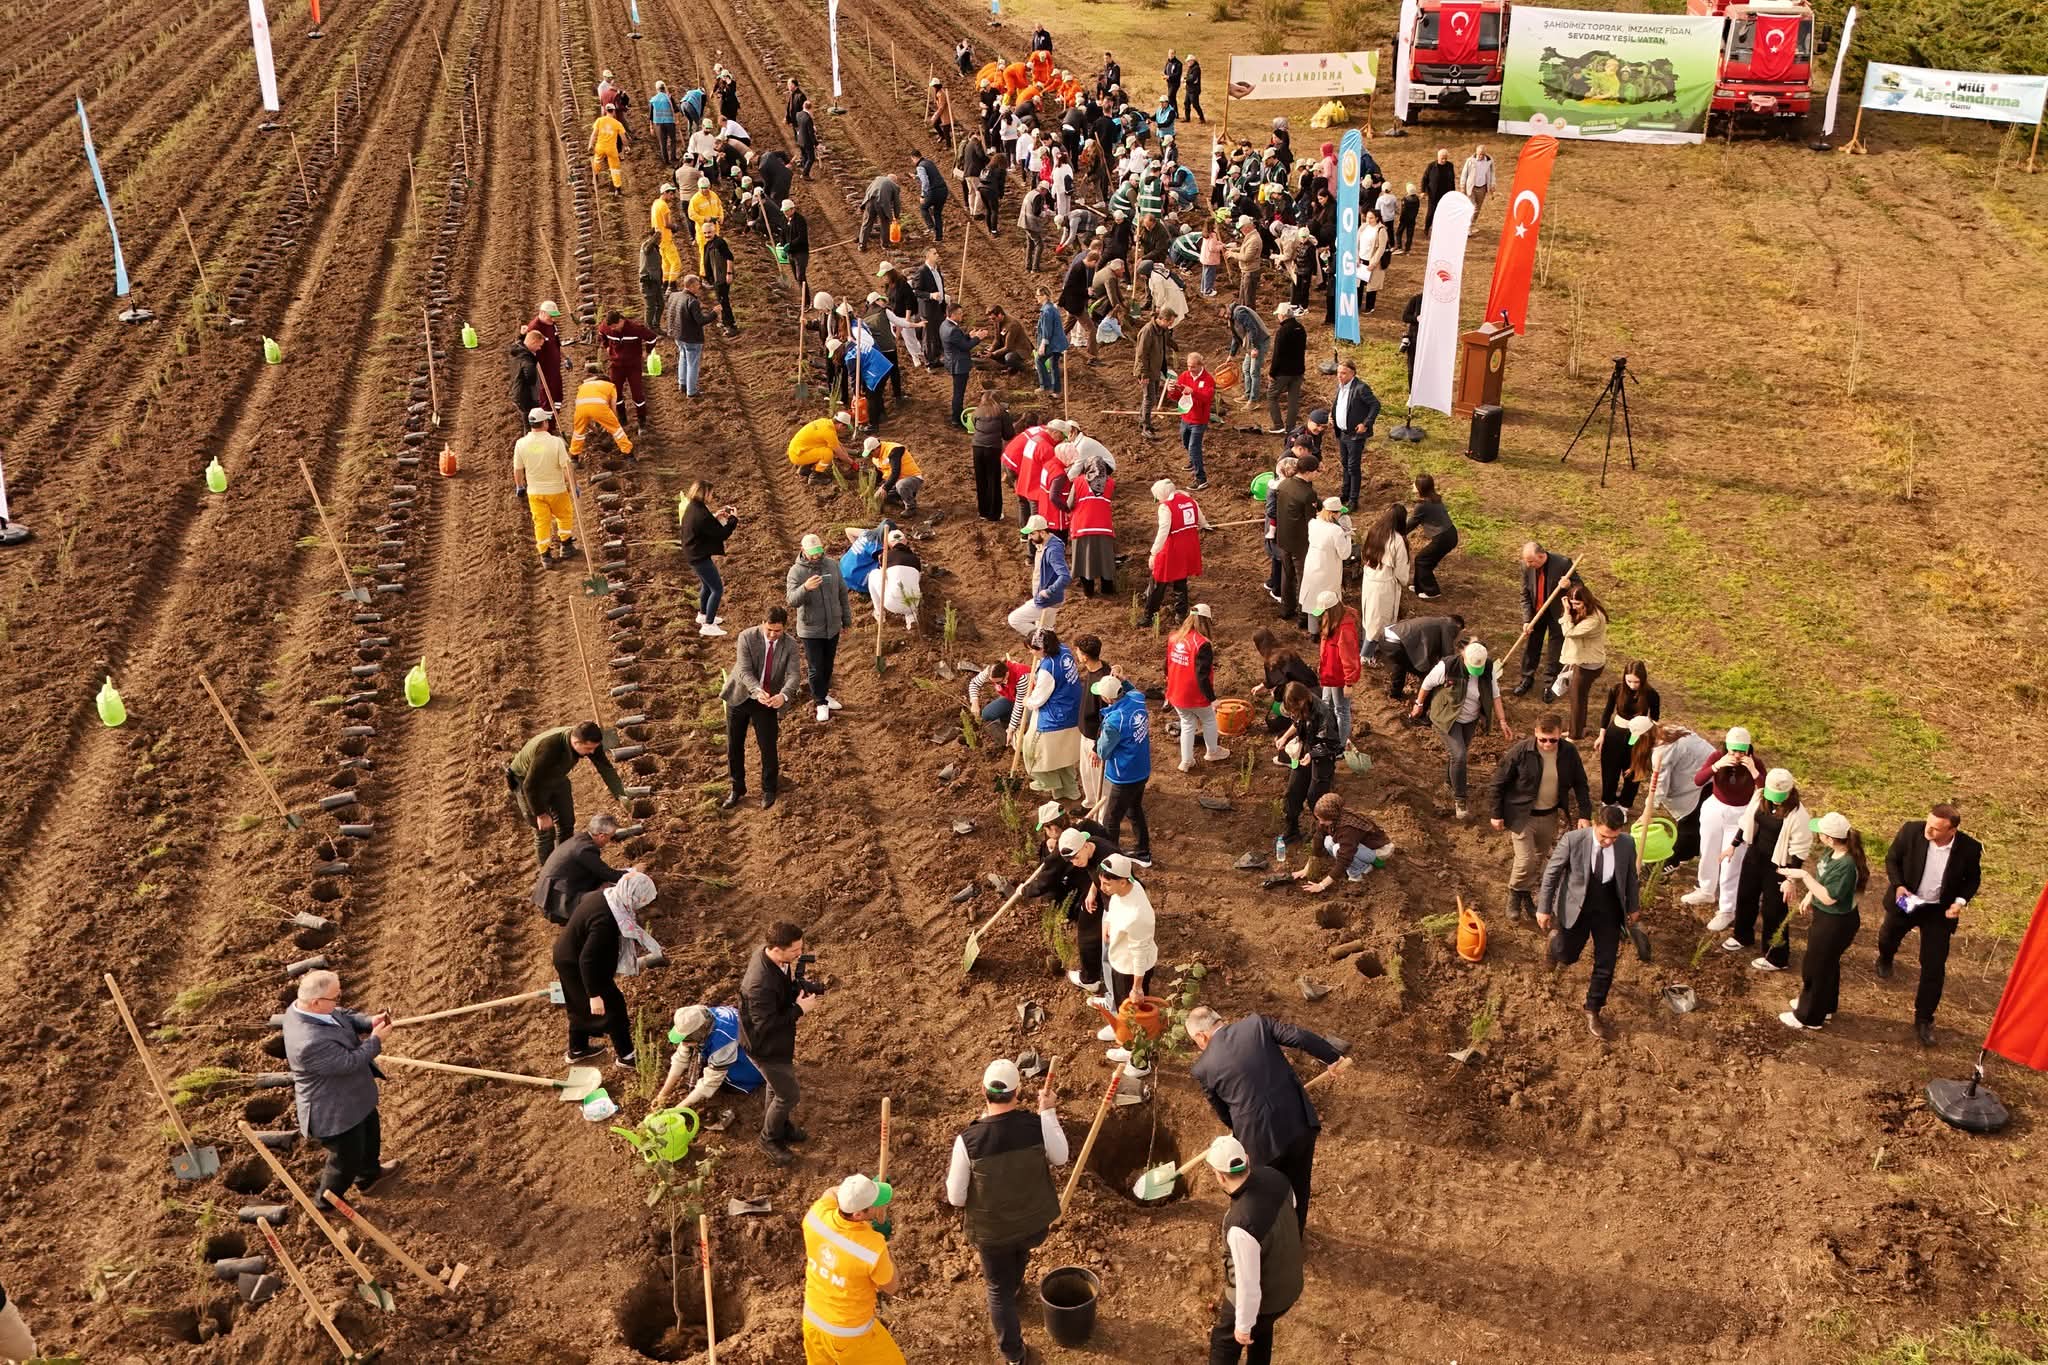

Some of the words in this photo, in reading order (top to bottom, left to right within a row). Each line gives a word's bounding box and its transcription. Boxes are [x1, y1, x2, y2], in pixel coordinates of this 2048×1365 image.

[1568, 32, 1610, 41] SEVDAMIZ
[1261, 71, 1343, 83] AĞAÇLANDIRMA
[1957, 82, 1985, 93] Milli
[1914, 87, 2020, 108] Ağaçlandırma
